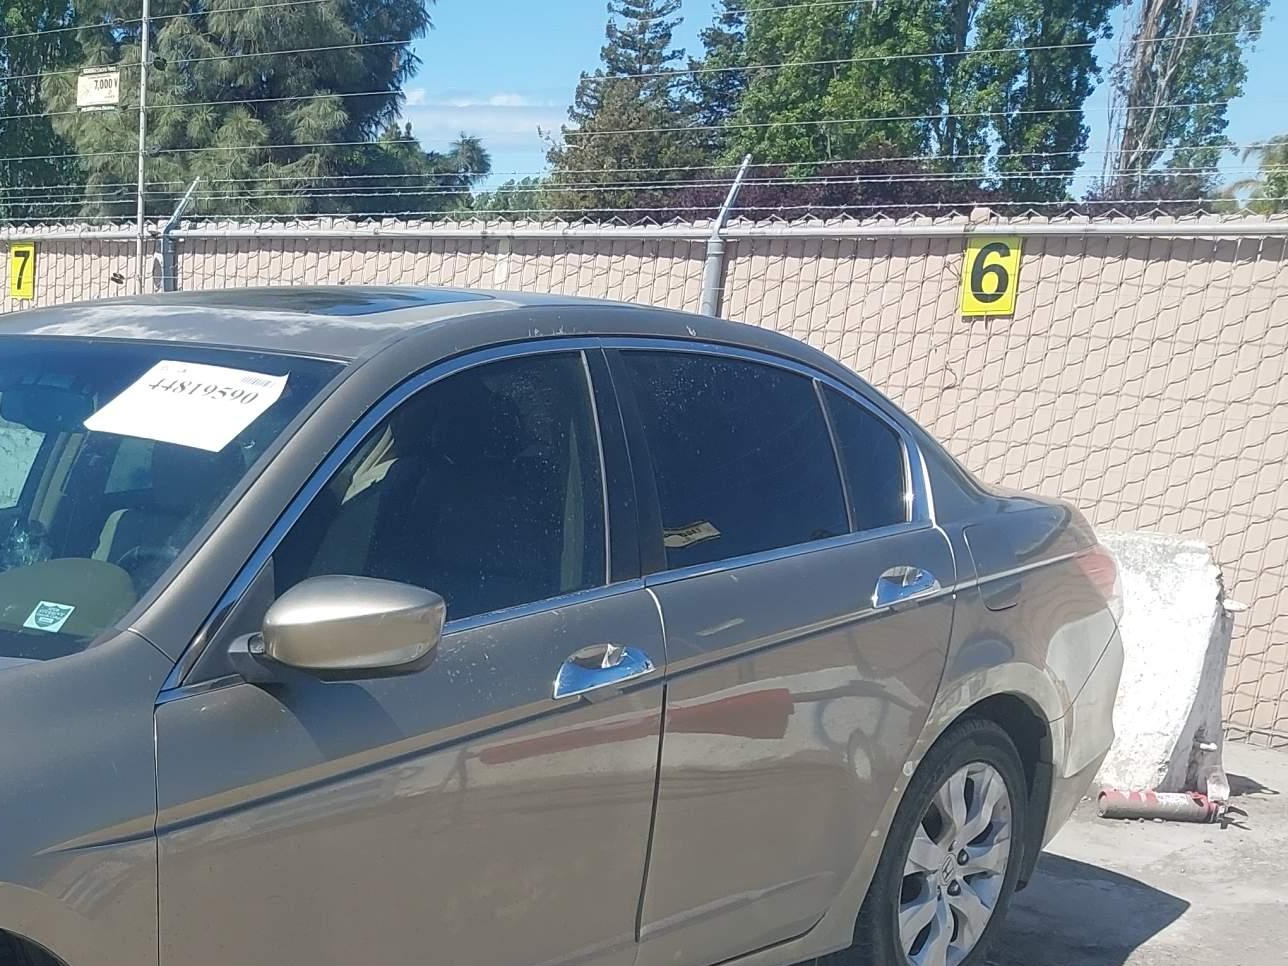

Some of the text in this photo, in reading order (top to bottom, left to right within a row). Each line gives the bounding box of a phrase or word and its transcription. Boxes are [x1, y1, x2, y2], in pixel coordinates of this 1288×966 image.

[94, 78, 113, 91] 7,000
[14, 250, 30, 290] 7
[970, 242, 1011, 304] 6
[148, 377, 259, 405] 44819590
